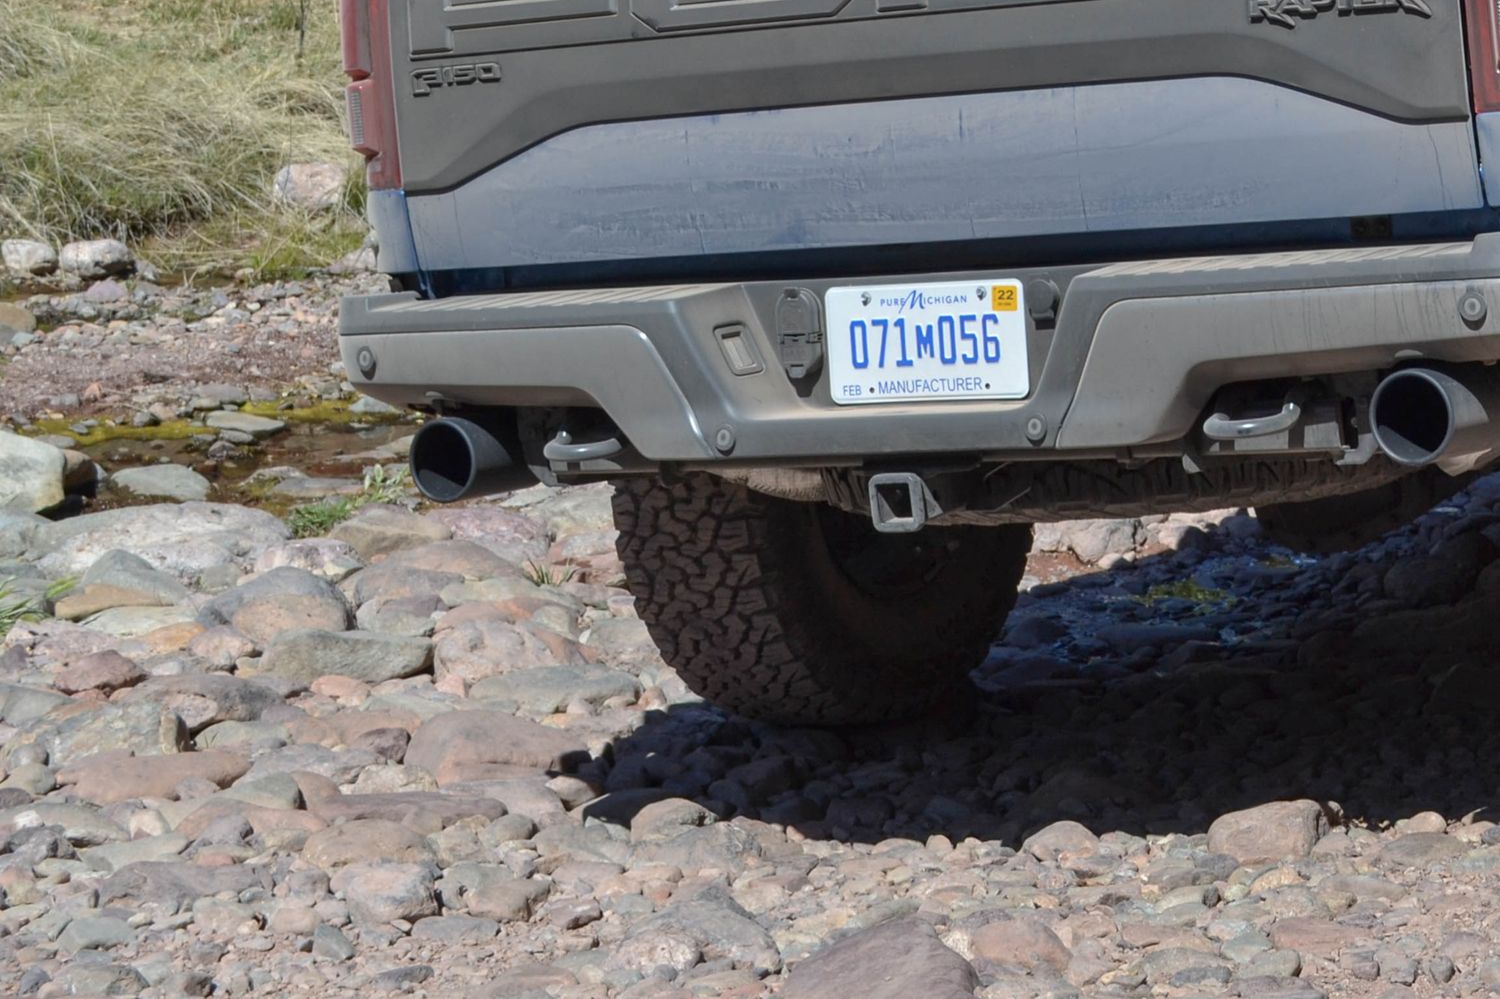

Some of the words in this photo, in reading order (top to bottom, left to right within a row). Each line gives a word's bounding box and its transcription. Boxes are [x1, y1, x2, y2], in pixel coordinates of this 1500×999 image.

[997, 289, 1014, 301] 22
[880, 297, 906, 307] PURE
[849, 314, 1001, 369] 071M056
[843, 384, 862, 397] FEB
[878, 376, 983, 395] MANUFACTURER
